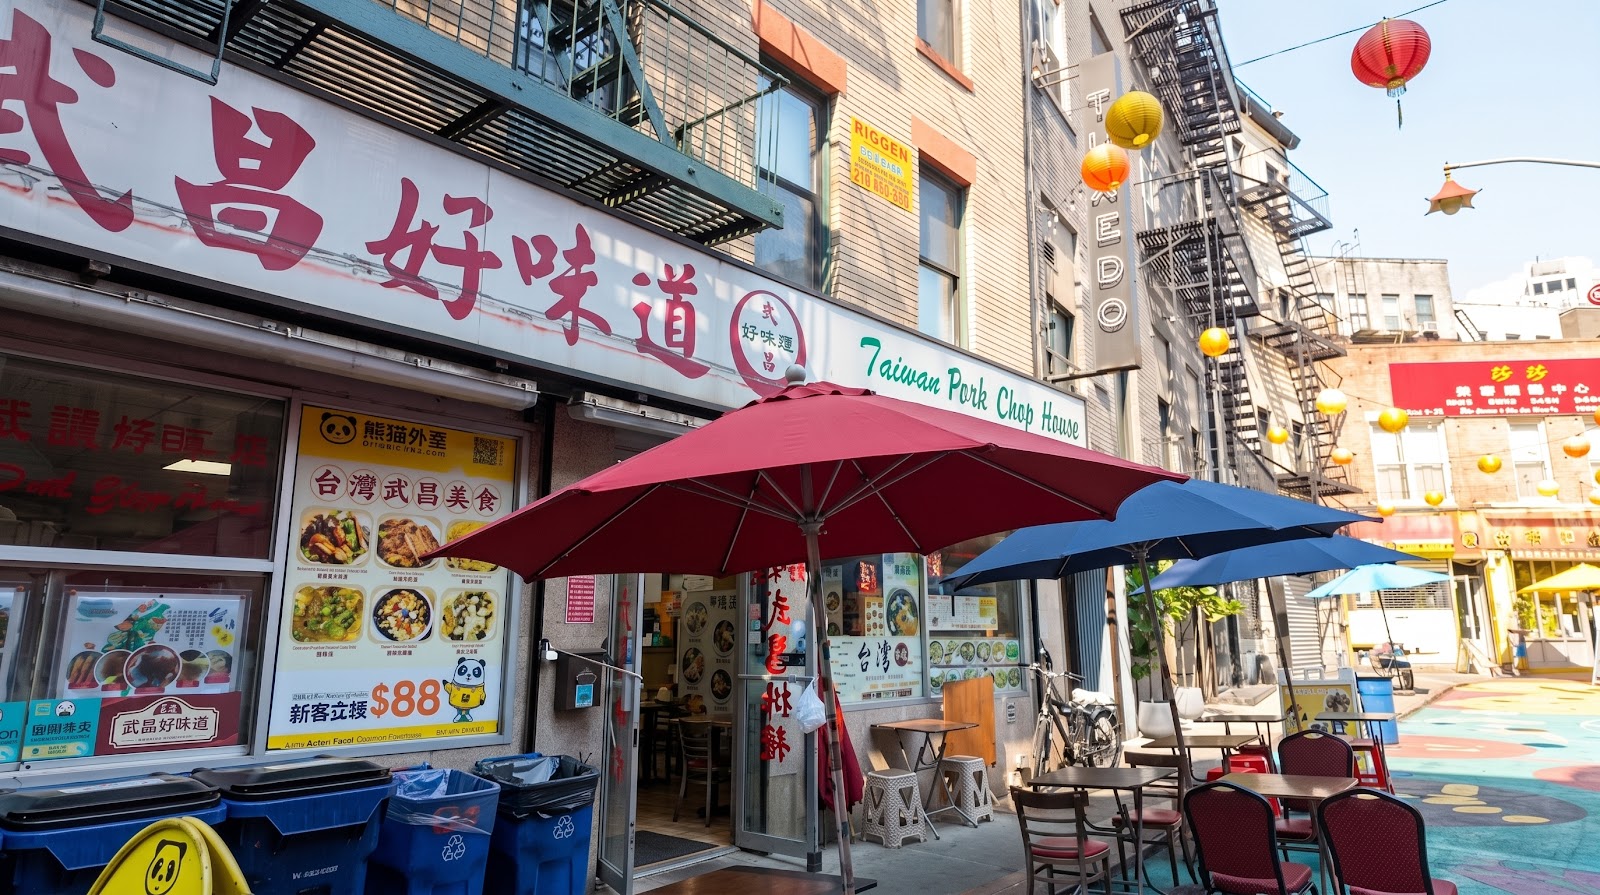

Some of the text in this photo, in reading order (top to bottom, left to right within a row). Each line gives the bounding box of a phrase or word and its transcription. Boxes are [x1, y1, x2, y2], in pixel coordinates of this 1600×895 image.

[854, 120, 908, 163] RIGGEN
[860, 336, 1080, 440] Taiwan Pork Chop House
[314, 468, 499, 513] 台灣武昌美食
[370, 679, 441, 719] $88
